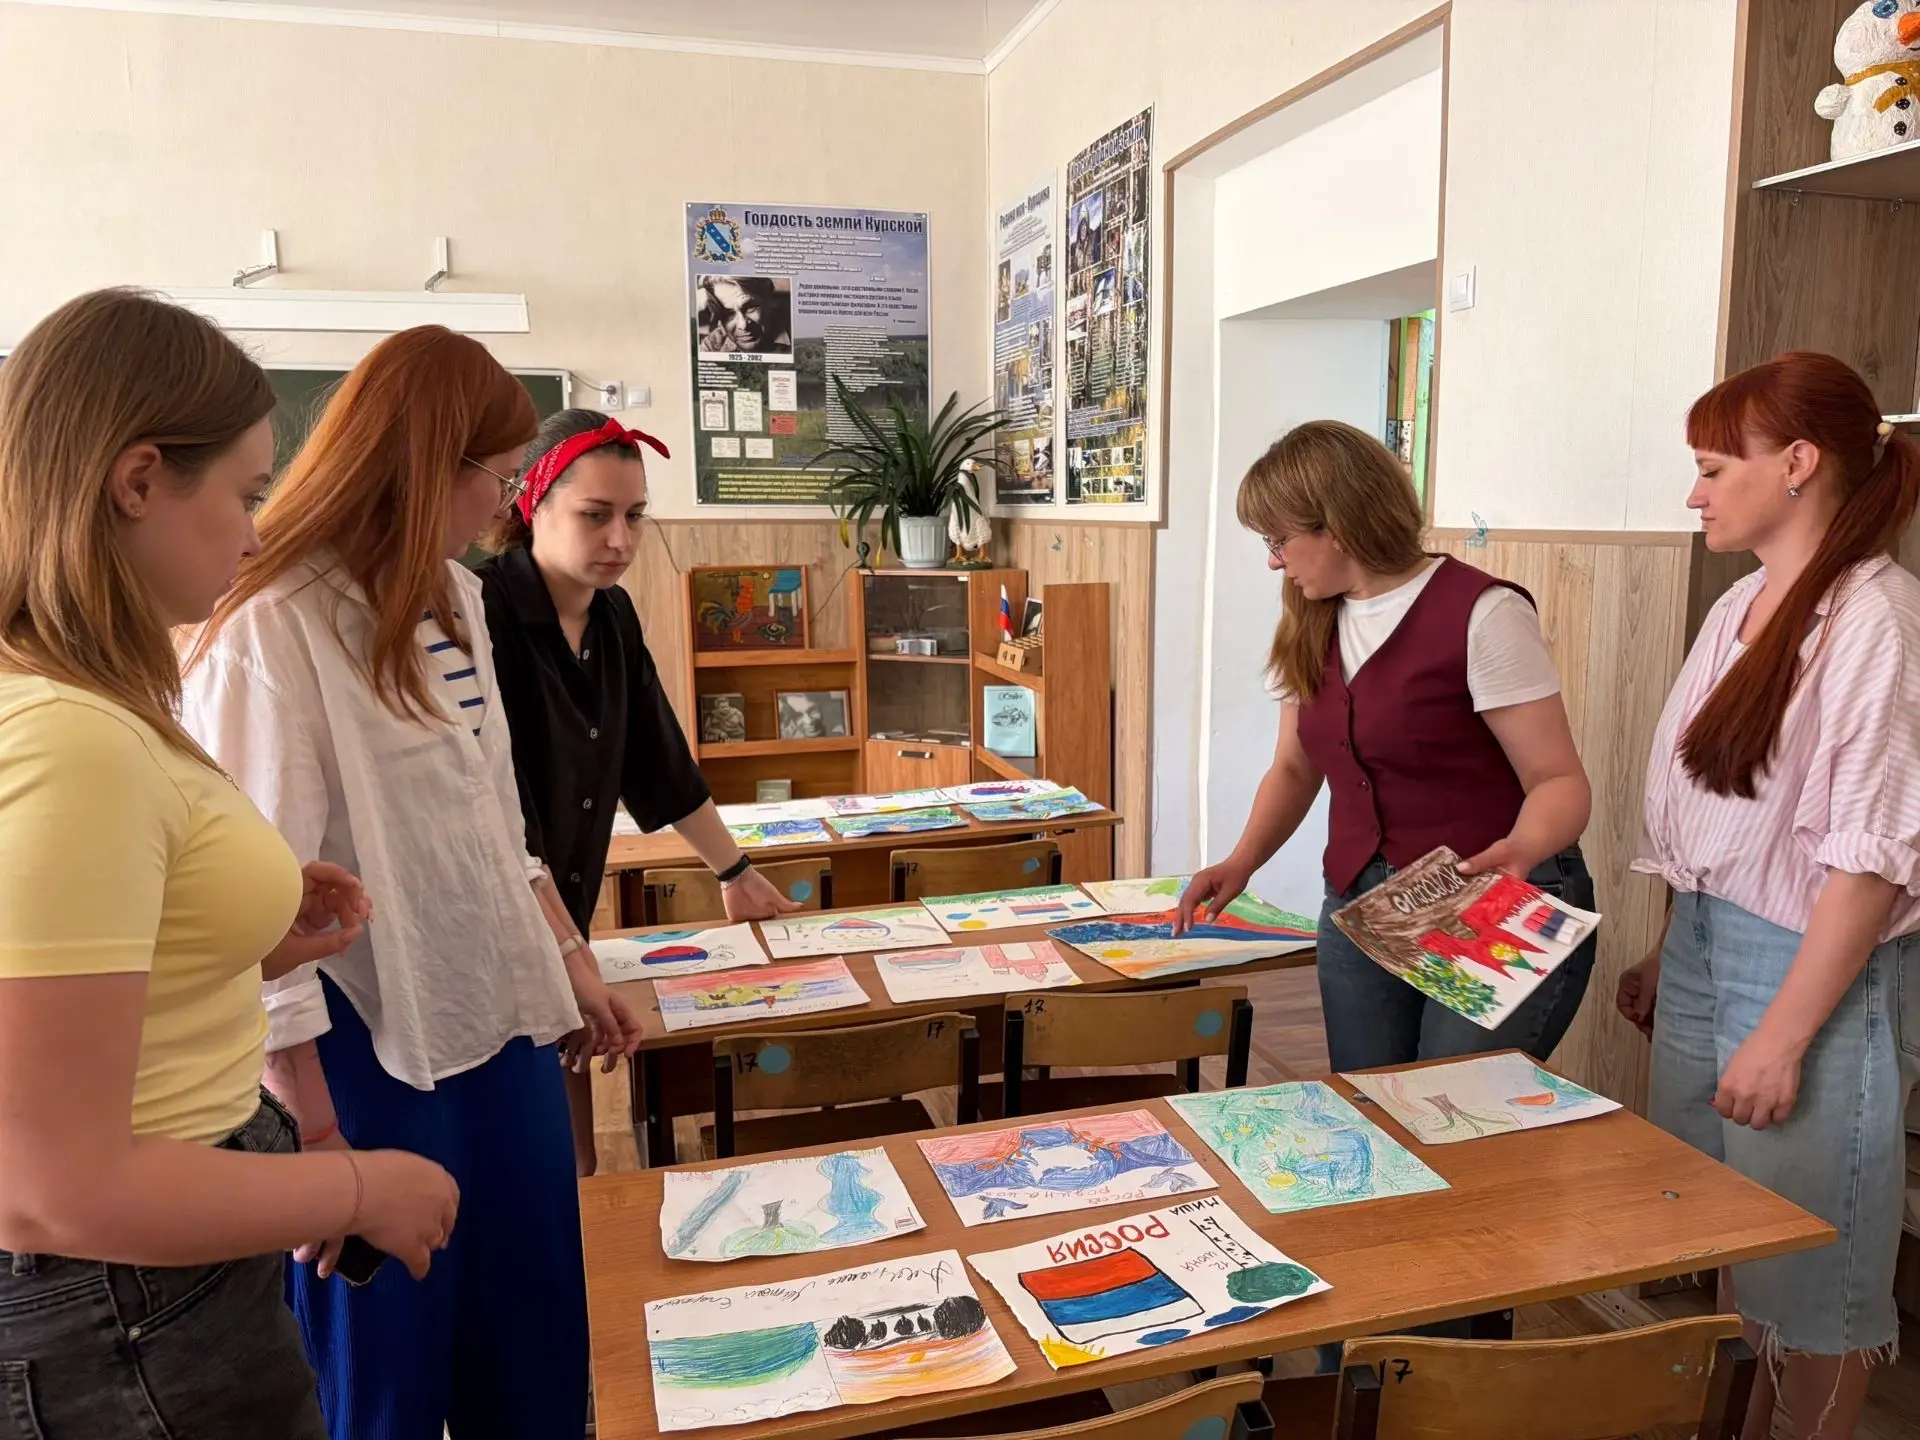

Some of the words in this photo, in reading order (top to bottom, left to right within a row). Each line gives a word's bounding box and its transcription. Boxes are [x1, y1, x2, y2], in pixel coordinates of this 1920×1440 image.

[744, 210, 812, 228] Гордость
[815, 215, 862, 230] земли
[865, 215, 922, 233] Курской
[728, 353, 743, 361] 1925
[747, 354, 763, 362] 2002
[927, 1021, 945, 1039] 17
[1046, 1214, 1171, 1265] РОССИЯ
[1378, 1358, 1414, 1386] 17
